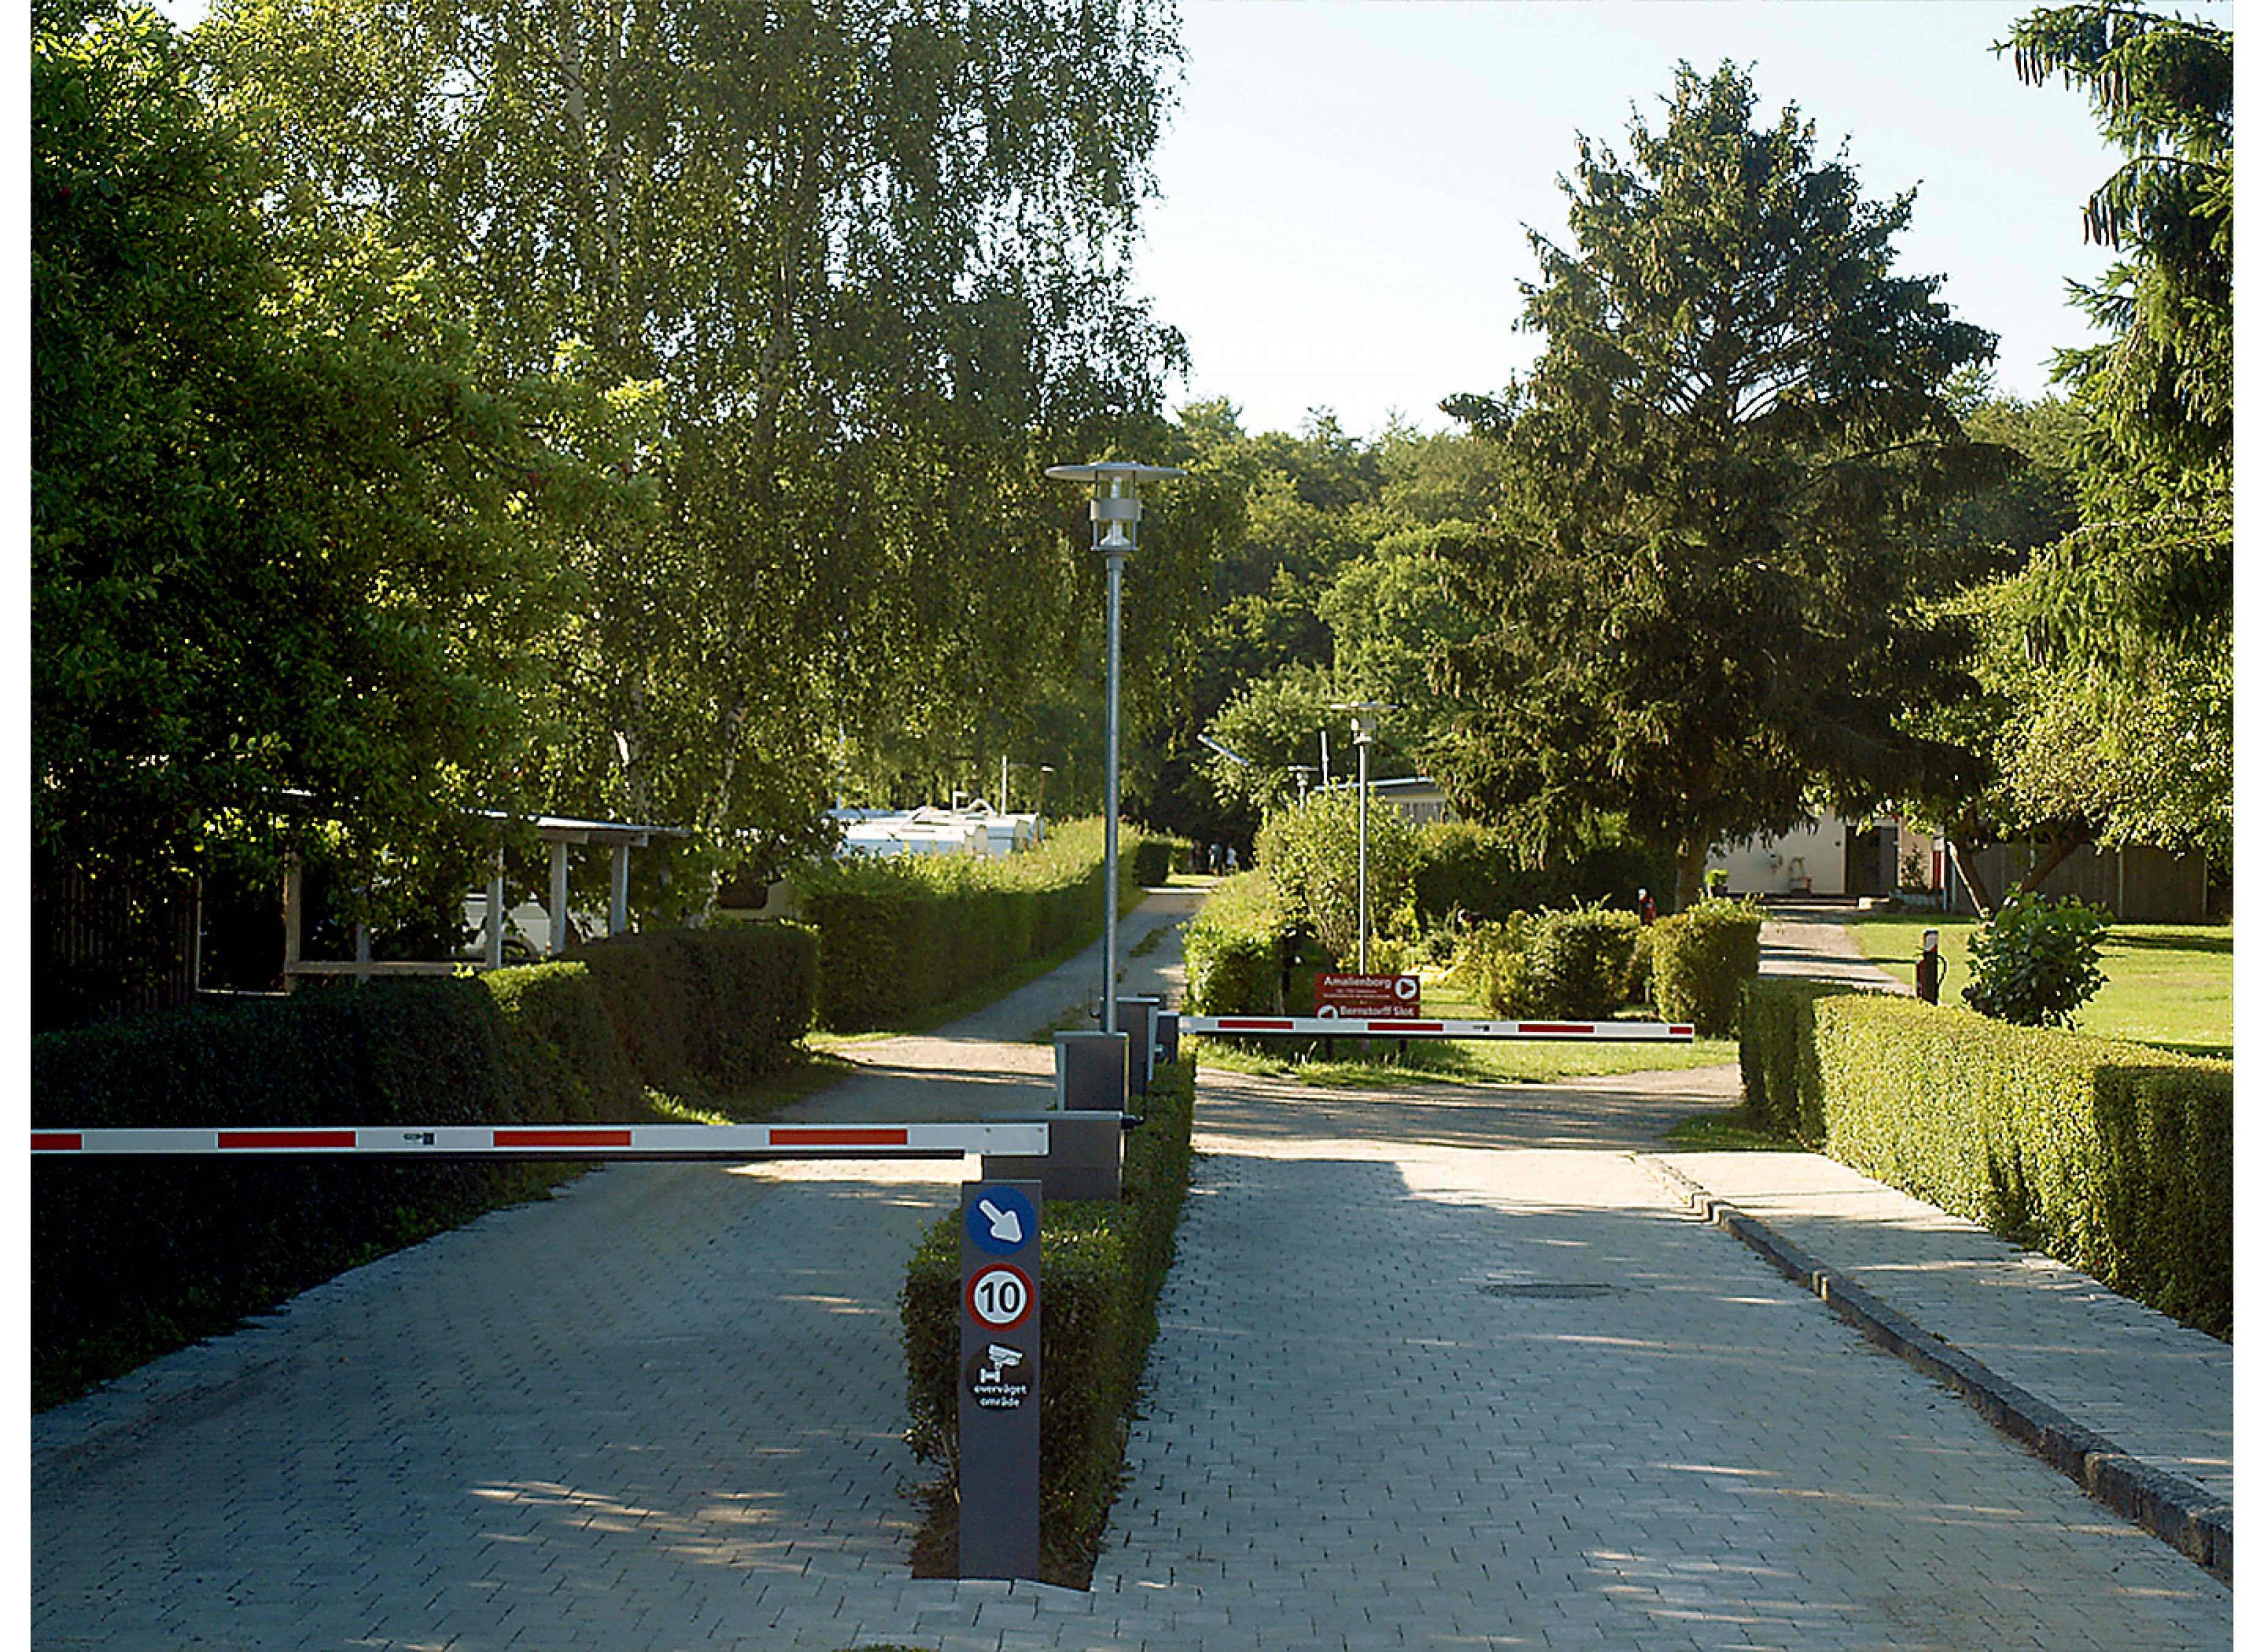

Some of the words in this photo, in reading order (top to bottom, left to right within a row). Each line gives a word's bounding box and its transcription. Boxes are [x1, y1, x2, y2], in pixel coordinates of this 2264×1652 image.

[1324, 977, 1392, 989] Amalienborg
[1393, 1005, 1414, 1016] Slot
[980, 1281, 1021, 1313] 10
[980, 1396, 1019, 1407] område
